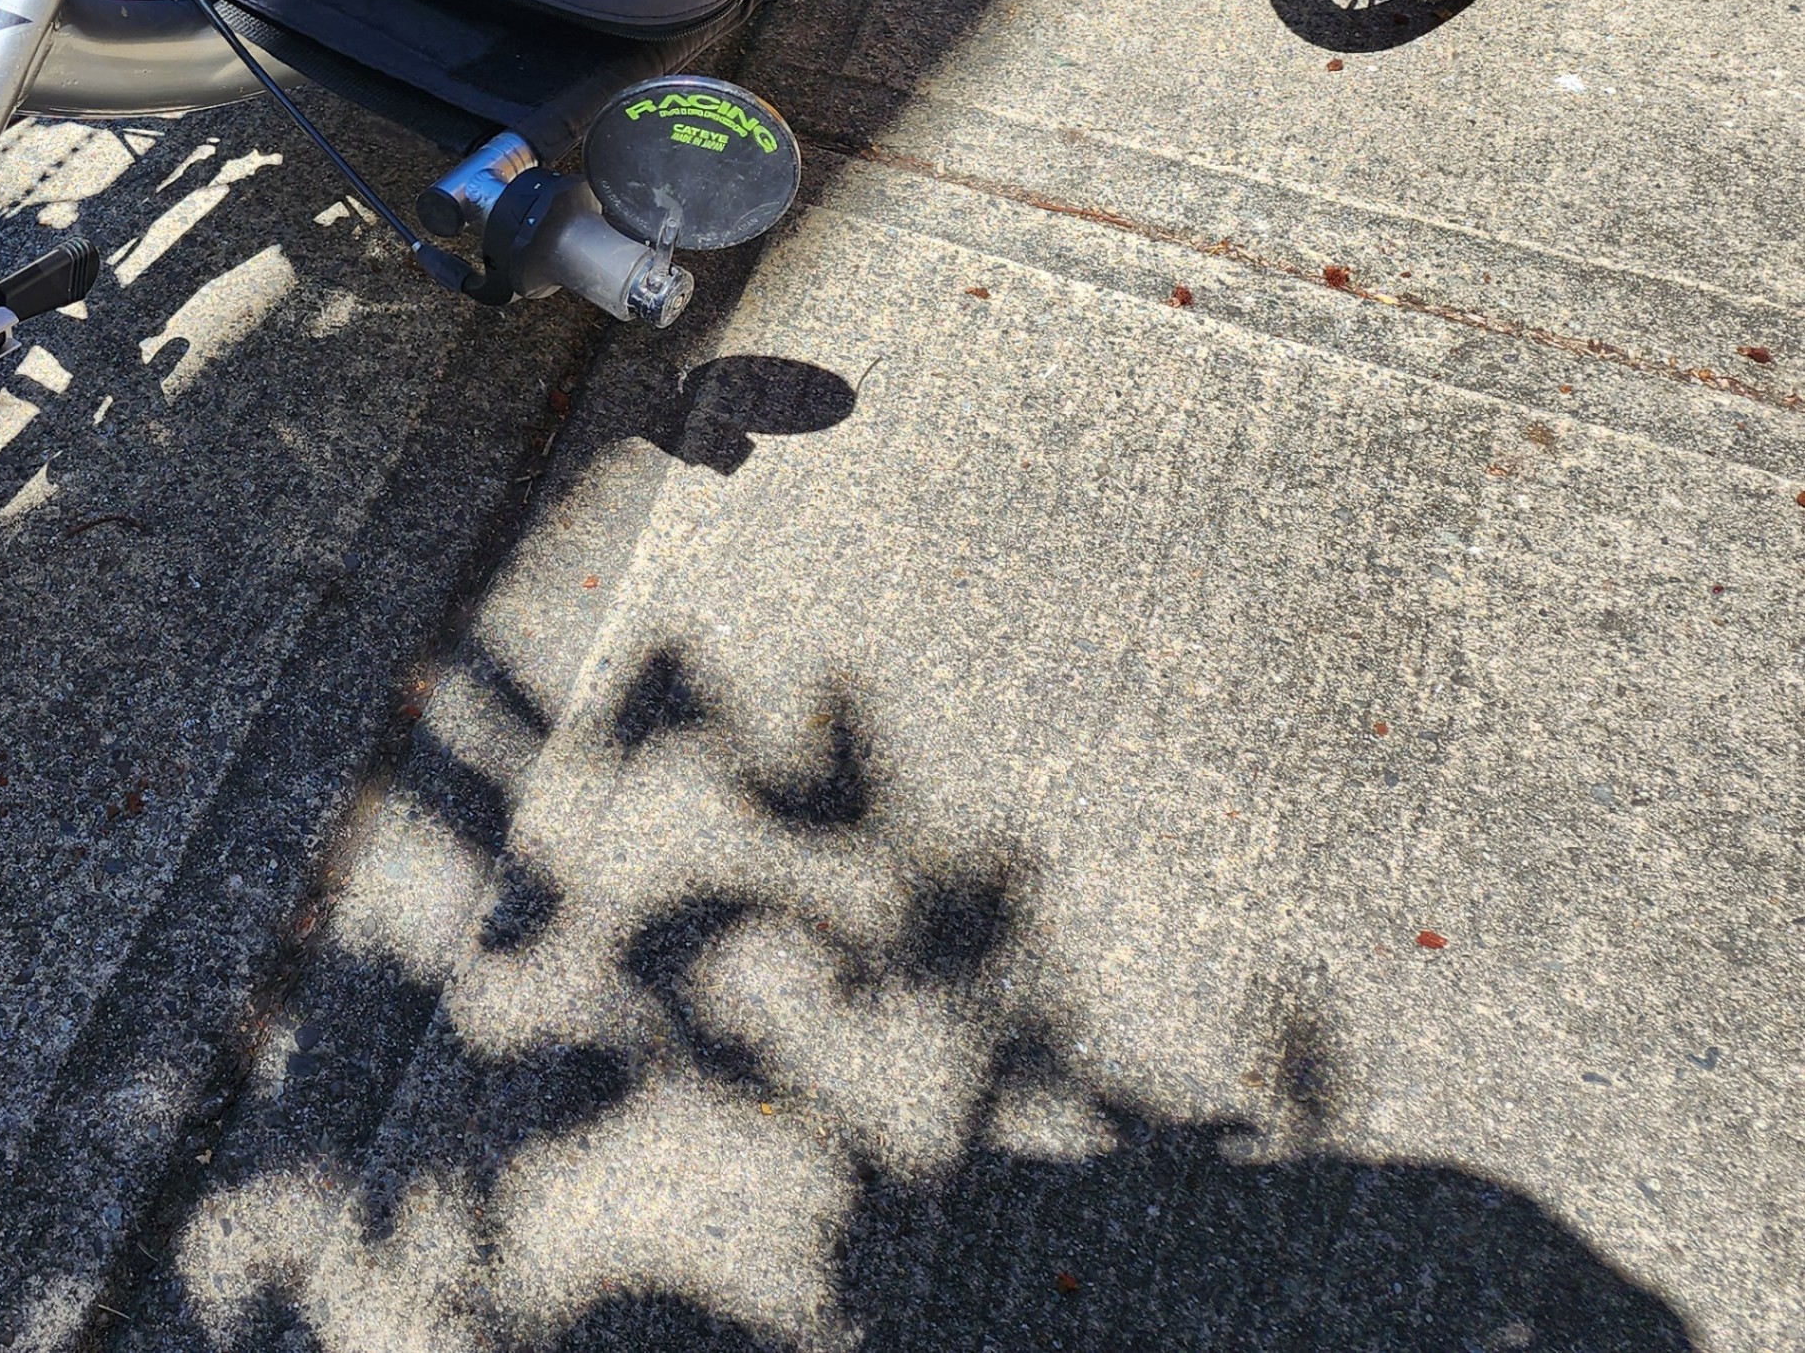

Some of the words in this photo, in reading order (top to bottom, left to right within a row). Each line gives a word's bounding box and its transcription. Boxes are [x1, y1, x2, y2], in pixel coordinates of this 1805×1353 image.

[625, 94, 778, 154] RACING
[659, 108, 749, 138] MIRROR
[670, 132, 693, 145] MADE
[701, 139, 727, 153] JAPAN
